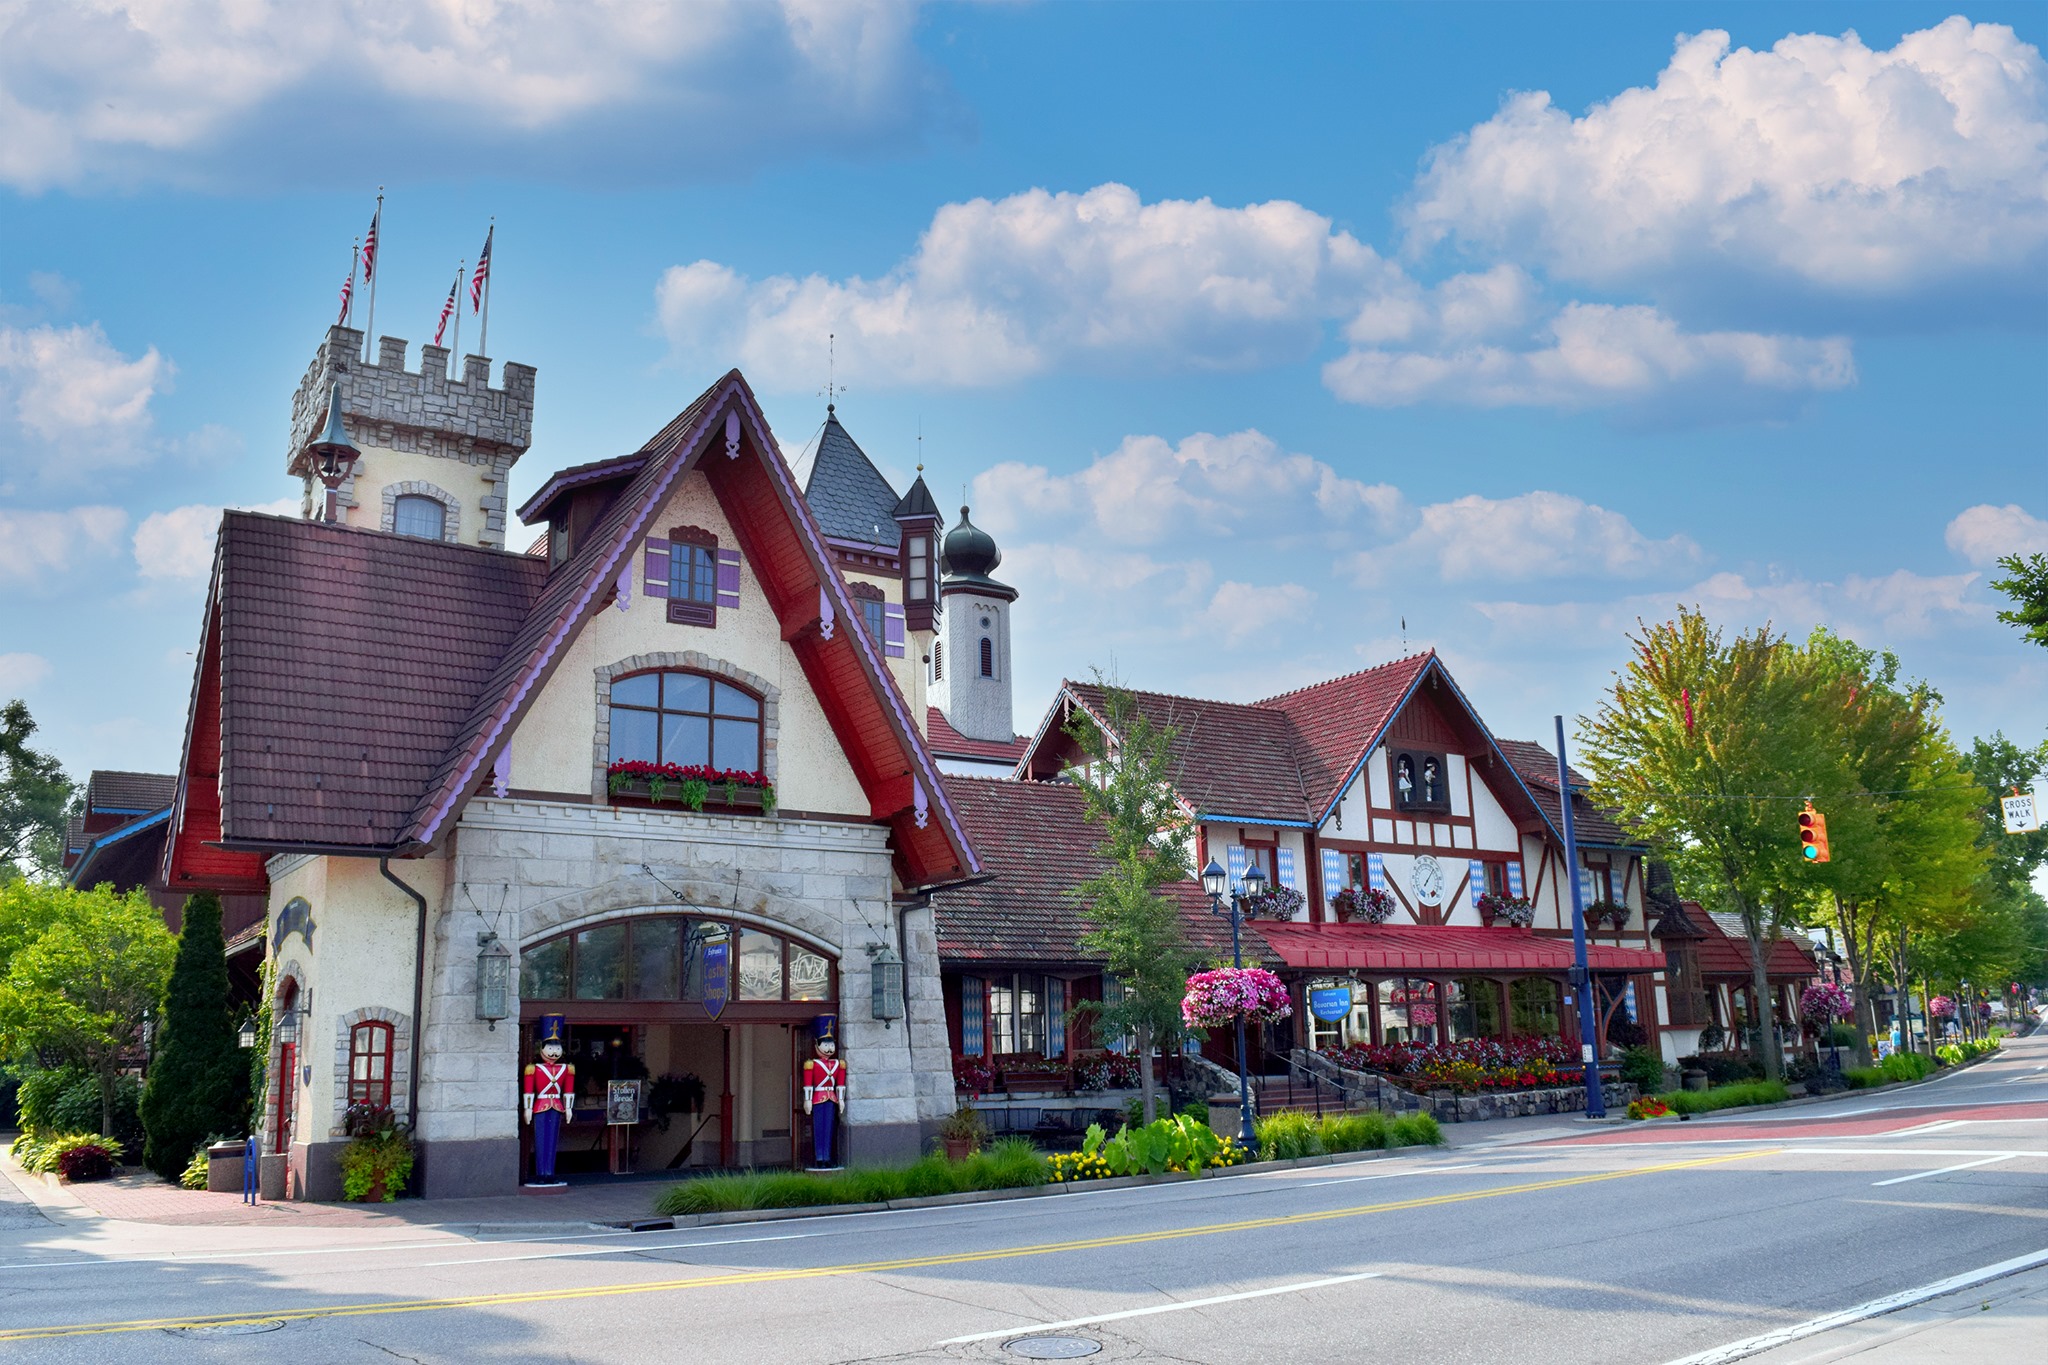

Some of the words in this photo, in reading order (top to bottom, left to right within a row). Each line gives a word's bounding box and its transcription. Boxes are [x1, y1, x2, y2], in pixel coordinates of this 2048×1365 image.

[2004, 799, 2032, 809] CROSS
[2008, 809, 2031, 819] WALK
[704, 963, 725, 979] Castle
[704, 983, 725, 1004] Shops
[1313, 1000, 1338, 1009] Bavarian
[1338, 998, 1349, 1006] Inn
[613, 1093, 634, 1102] Bread
